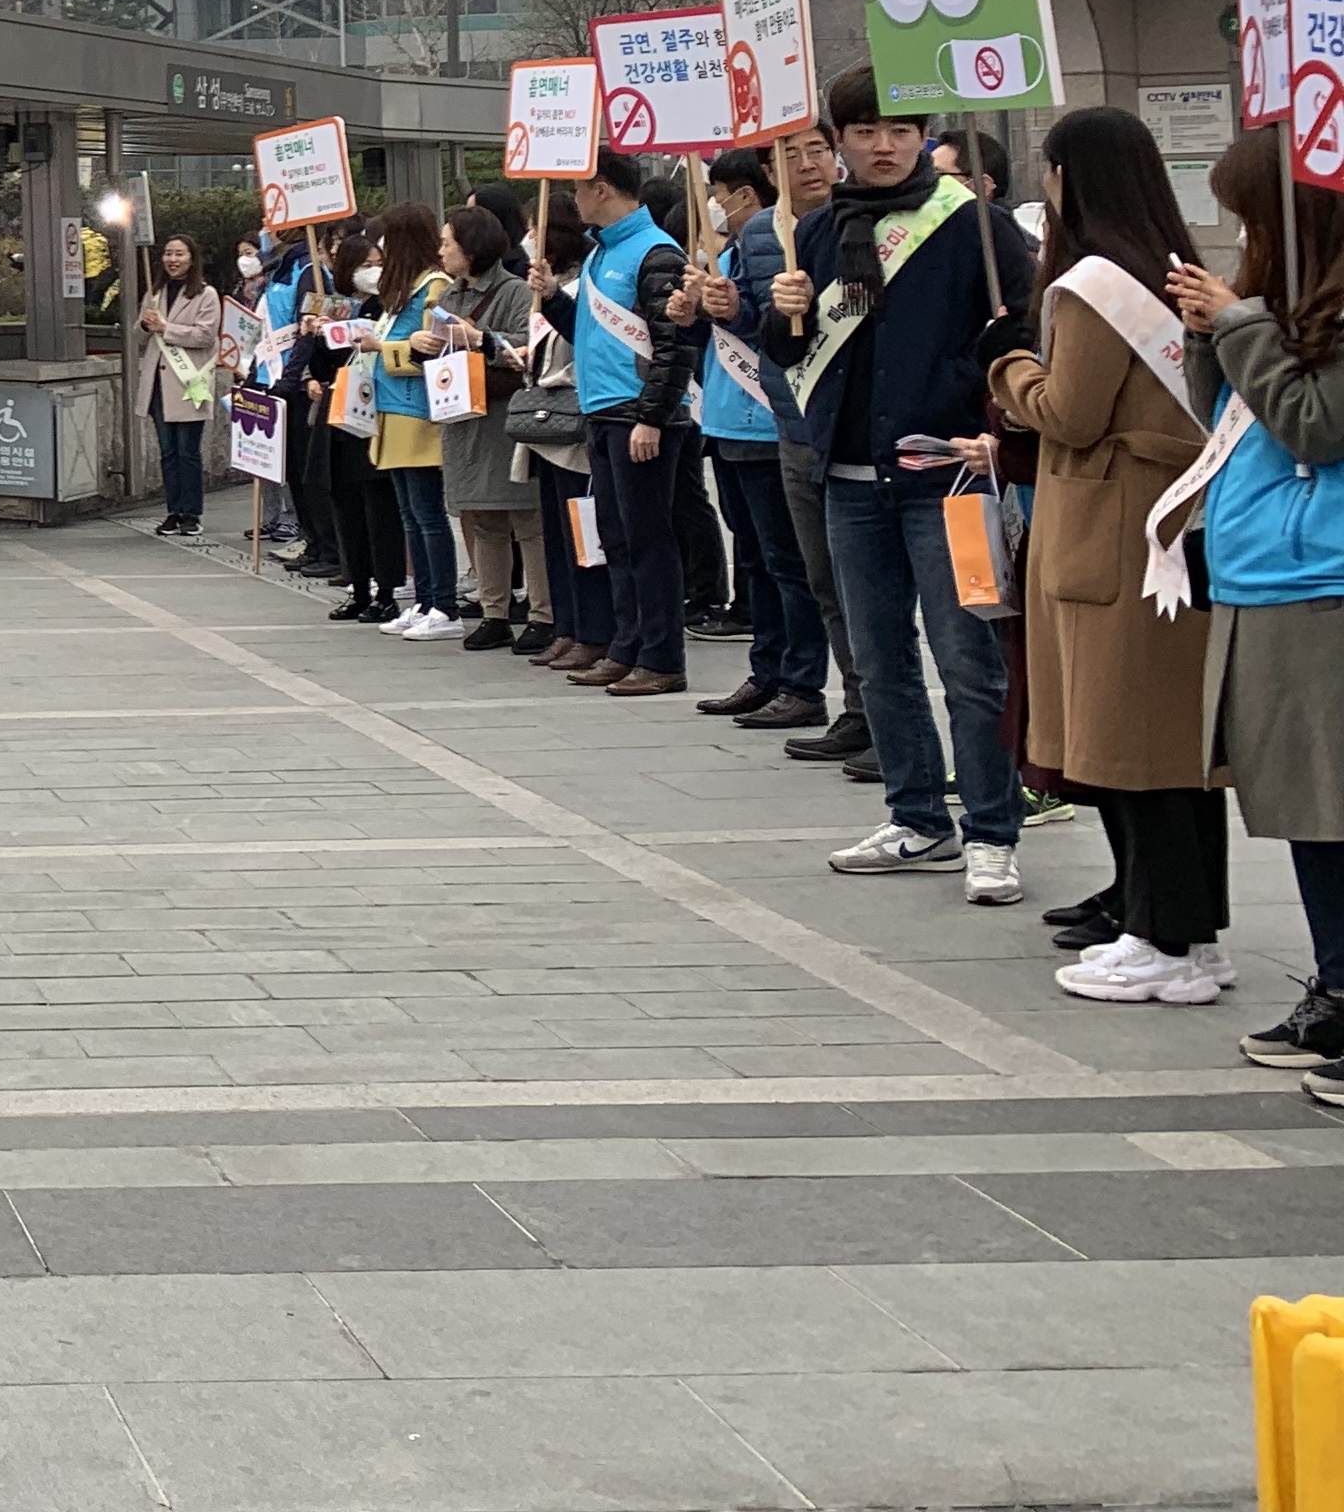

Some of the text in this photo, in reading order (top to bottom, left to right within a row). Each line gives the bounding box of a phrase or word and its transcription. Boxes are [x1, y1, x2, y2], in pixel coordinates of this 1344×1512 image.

[661, 29, 710, 53] 절주와
[1307, 12, 1344, 58] 건강
[624, 59, 730, 85] 건강생활 실천
[529, 76, 569, 98] 흡연매너
[1147, 92, 1177, 102] CCTV
[275, 136, 315, 162] 흡연매너
